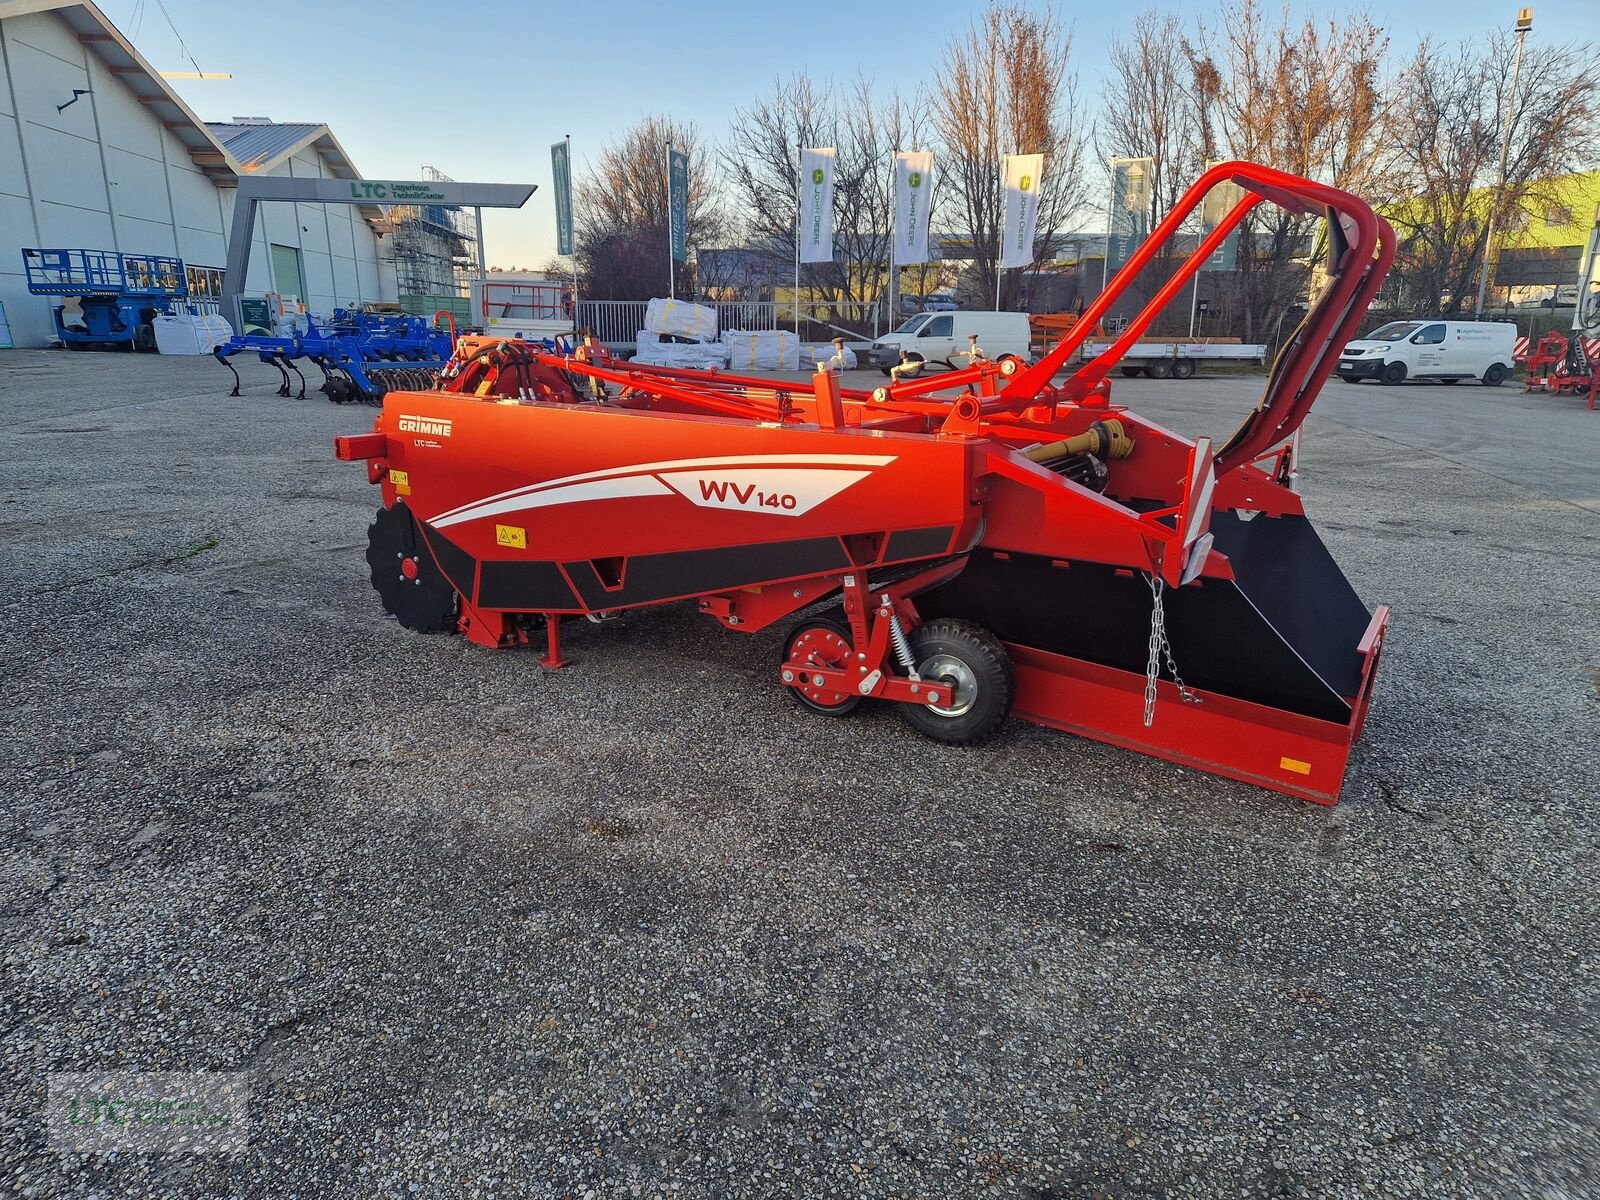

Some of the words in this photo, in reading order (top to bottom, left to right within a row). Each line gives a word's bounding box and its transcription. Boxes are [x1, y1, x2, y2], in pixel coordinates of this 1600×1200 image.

[351, 183, 386, 199] LTC
[391, 184, 430, 192] Lagerhaus
[392, 191, 445, 200] TechnikCenter
[909, 192, 917, 217] JOHN
[1019, 194, 1027, 220] JOHN
[813, 215, 821, 246] DEERE
[908, 217, 917, 247] DEERE
[1017, 221, 1026, 251] DEERE
